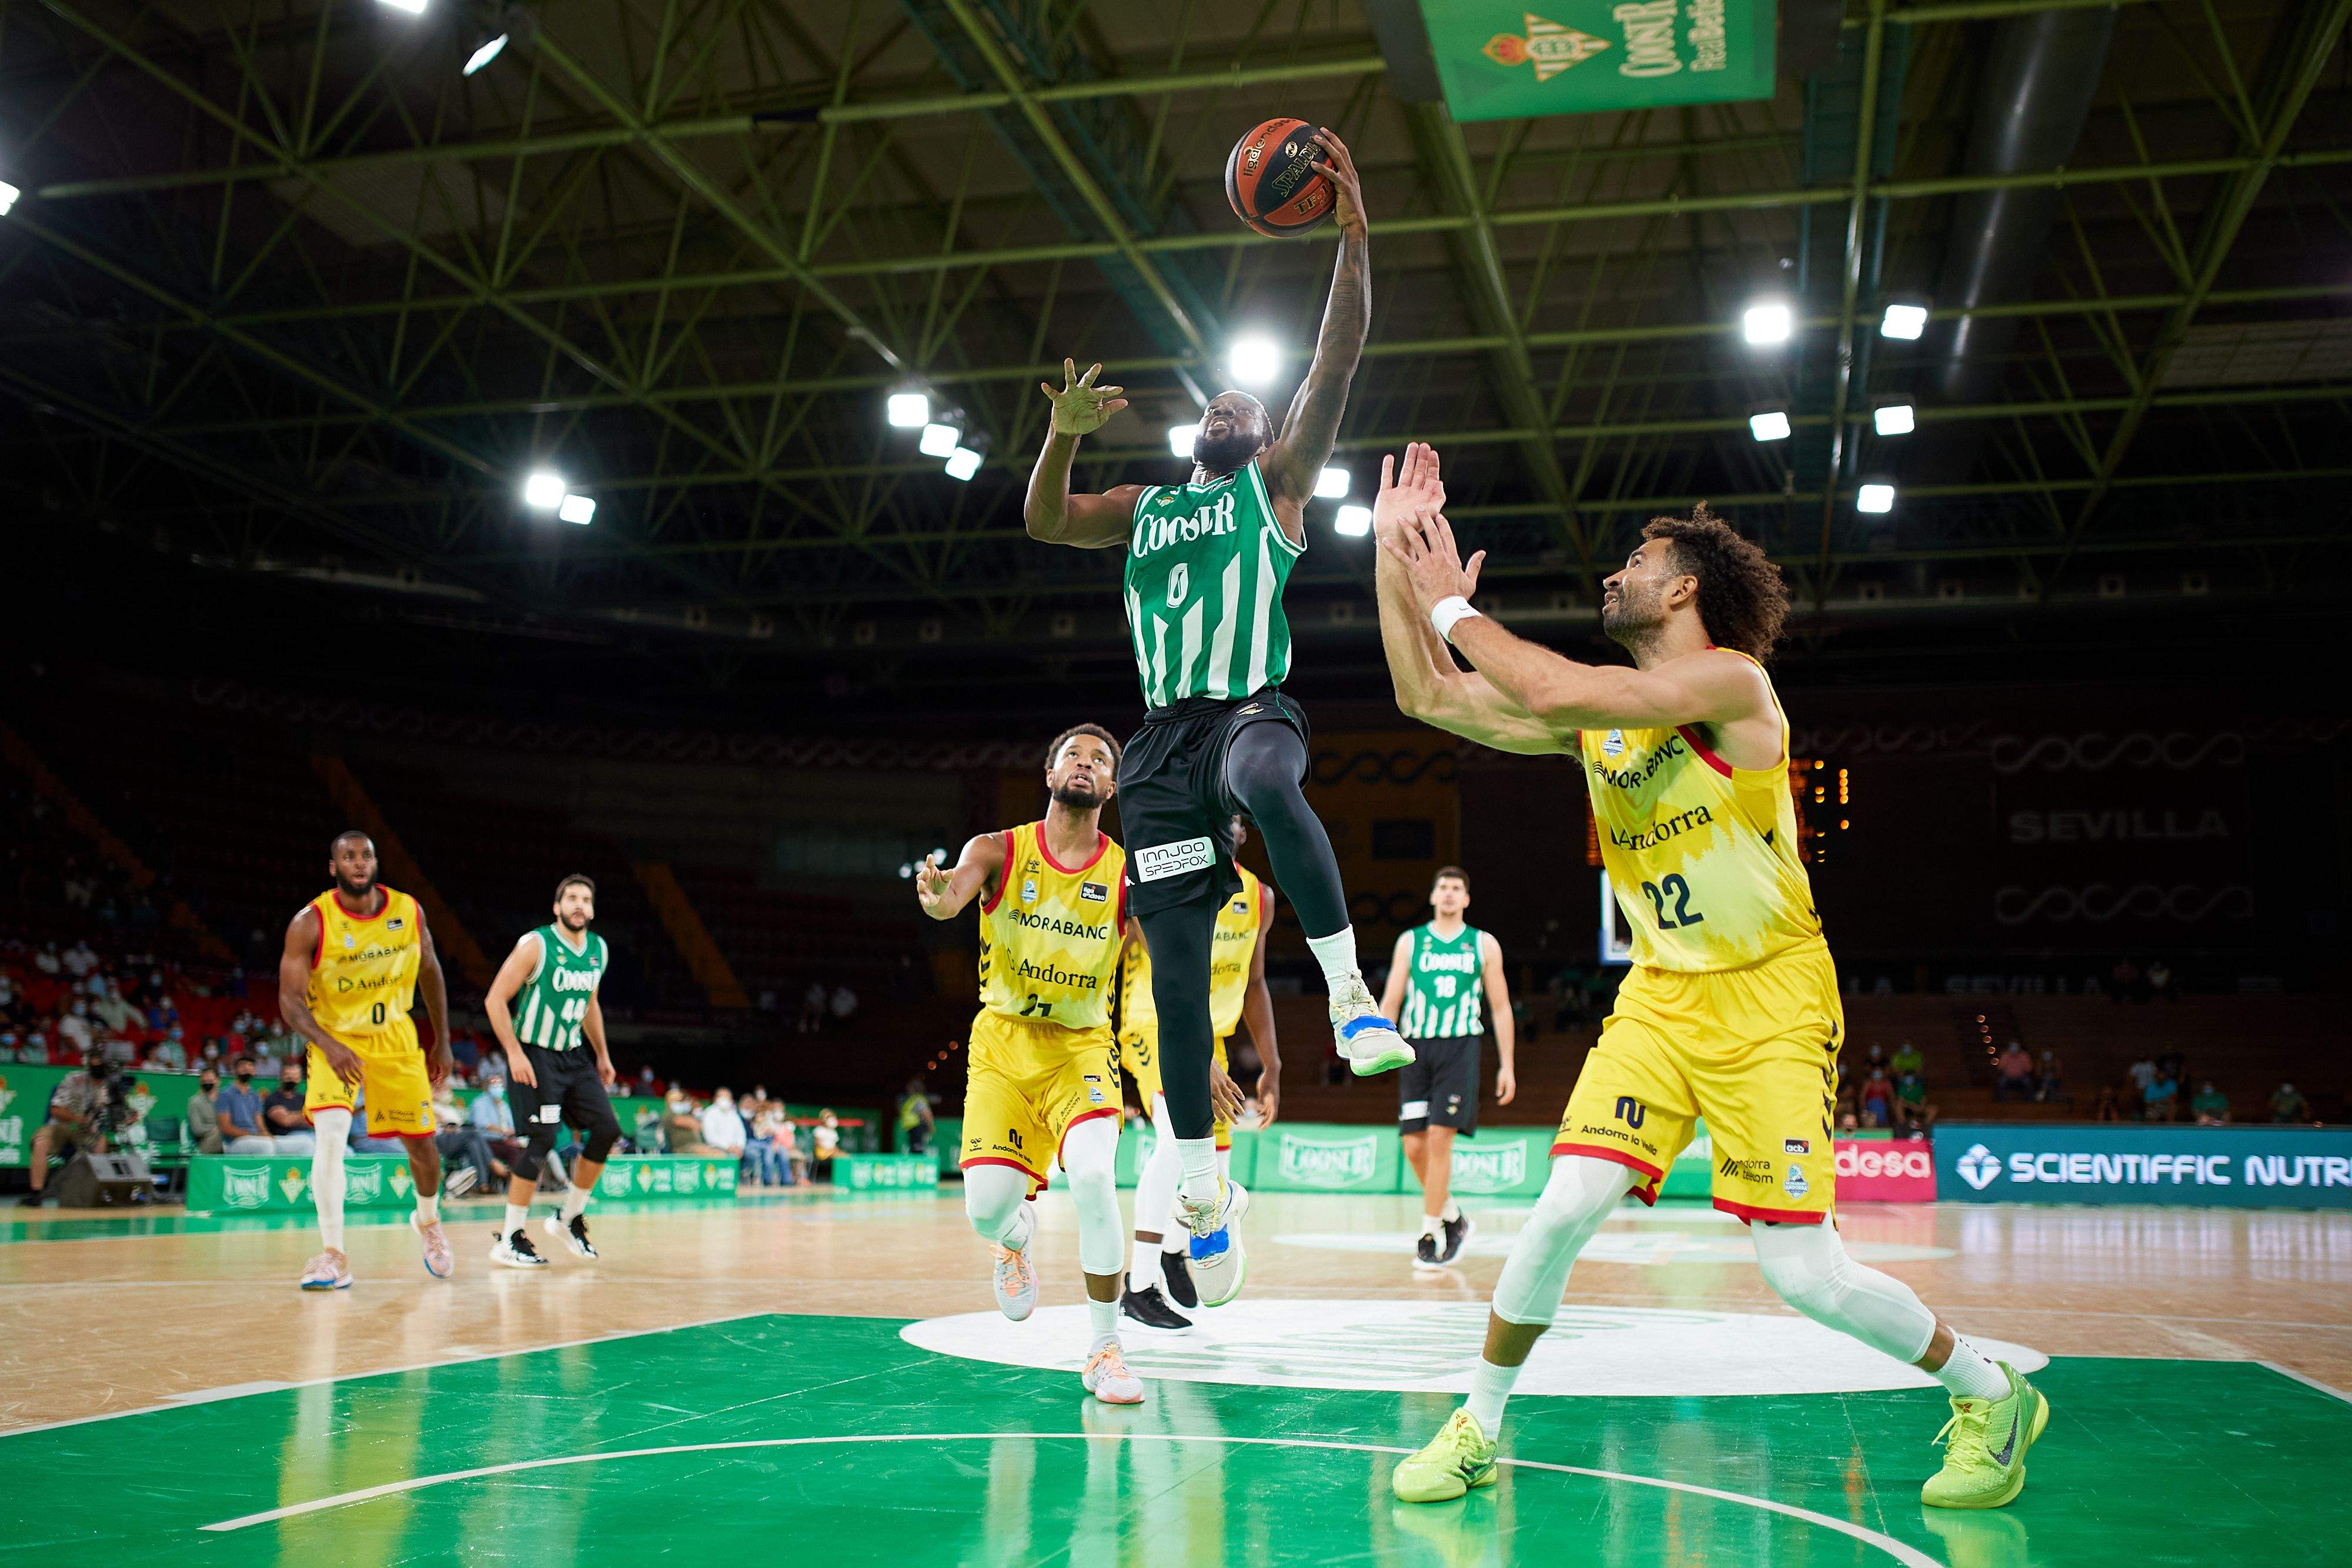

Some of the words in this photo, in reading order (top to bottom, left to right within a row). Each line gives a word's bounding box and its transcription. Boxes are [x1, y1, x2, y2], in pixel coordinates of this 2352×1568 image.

[1271, 135, 1321, 198] SPALDIN
[1167, 563, 1189, 609] 0
[1603, 735, 1685, 789] MORBANC
[1618, 806, 1713, 850] Andorra
[2008, 807, 2229, 844] SEVILLA
[1642, 874, 1704, 930] 22
[1017, 958, 1097, 989] Andorra
[1434, 975, 1456, 998] 18
[372, 1002, 385, 1024] 0
[560, 998, 586, 1024] 44
[1581, 1125, 1629, 1141] Andorra
[1631, 1135, 1639, 1145] la
[1642, 1139, 1658, 1156] Vella
[1786, 1145, 1805, 1153] acb
[1835, 1144, 1932, 1178] desa
[2009, 1152, 2231, 1185] SCIENTIFFIC
[2244, 1155, 2352, 1187] NUTR
